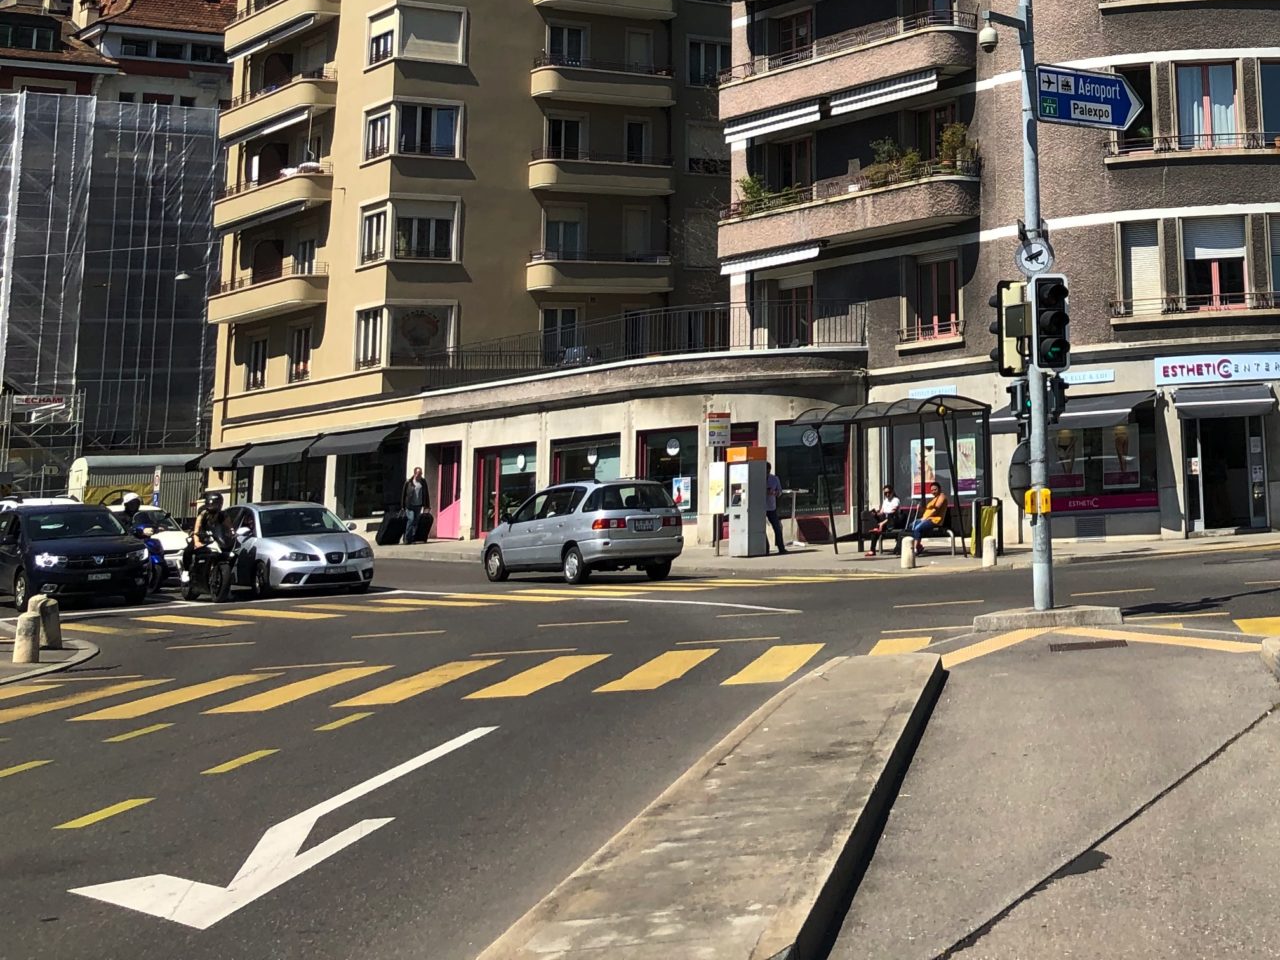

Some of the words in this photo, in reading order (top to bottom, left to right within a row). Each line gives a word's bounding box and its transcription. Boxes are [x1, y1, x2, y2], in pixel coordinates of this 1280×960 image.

[1078, 77, 1121, 102] Aéroport
[1072, 102, 1110, 120] Palexpo
[1162, 358, 1233, 379] ESTHETIC
